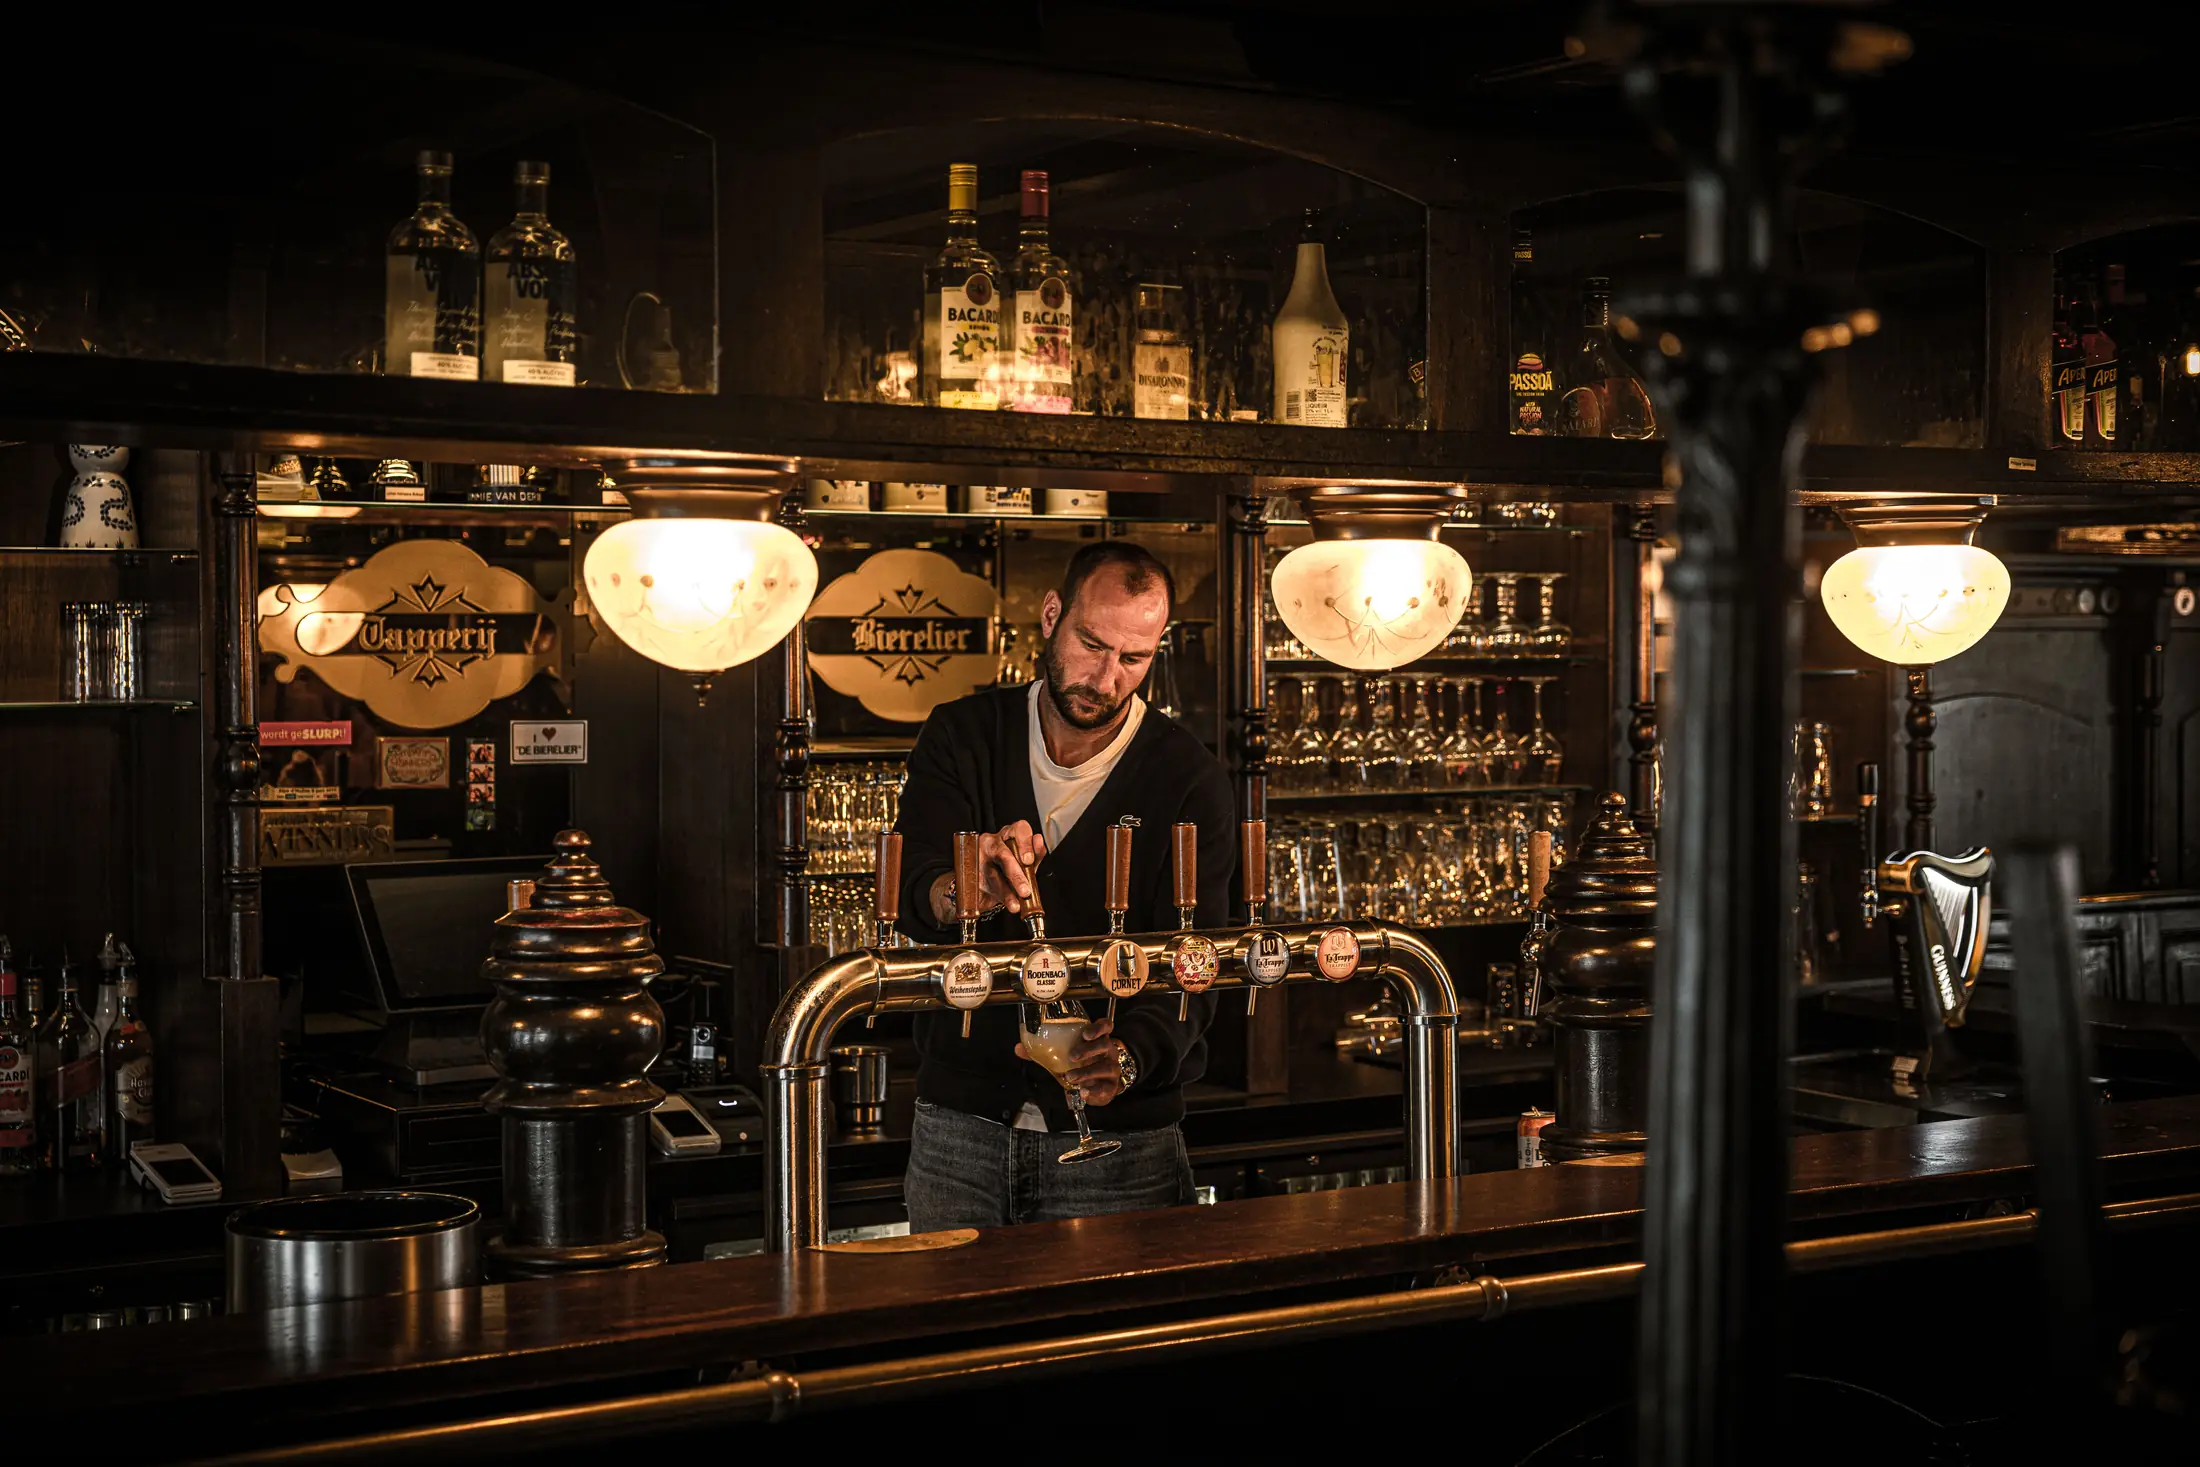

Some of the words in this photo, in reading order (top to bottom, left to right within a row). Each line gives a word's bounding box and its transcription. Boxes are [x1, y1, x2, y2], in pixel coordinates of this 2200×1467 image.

[495, 491, 516, 501] VAN
[850, 617, 972, 652] Bierelier
[1042, 958, 1049, 968] R
[1027, 970, 1066, 979] RODENBACH
[1930, 944, 1957, 1011] GUINNESS
[949, 984, 987, 994] Weihenstephan
[1111, 977, 1142, 991] CORNET
